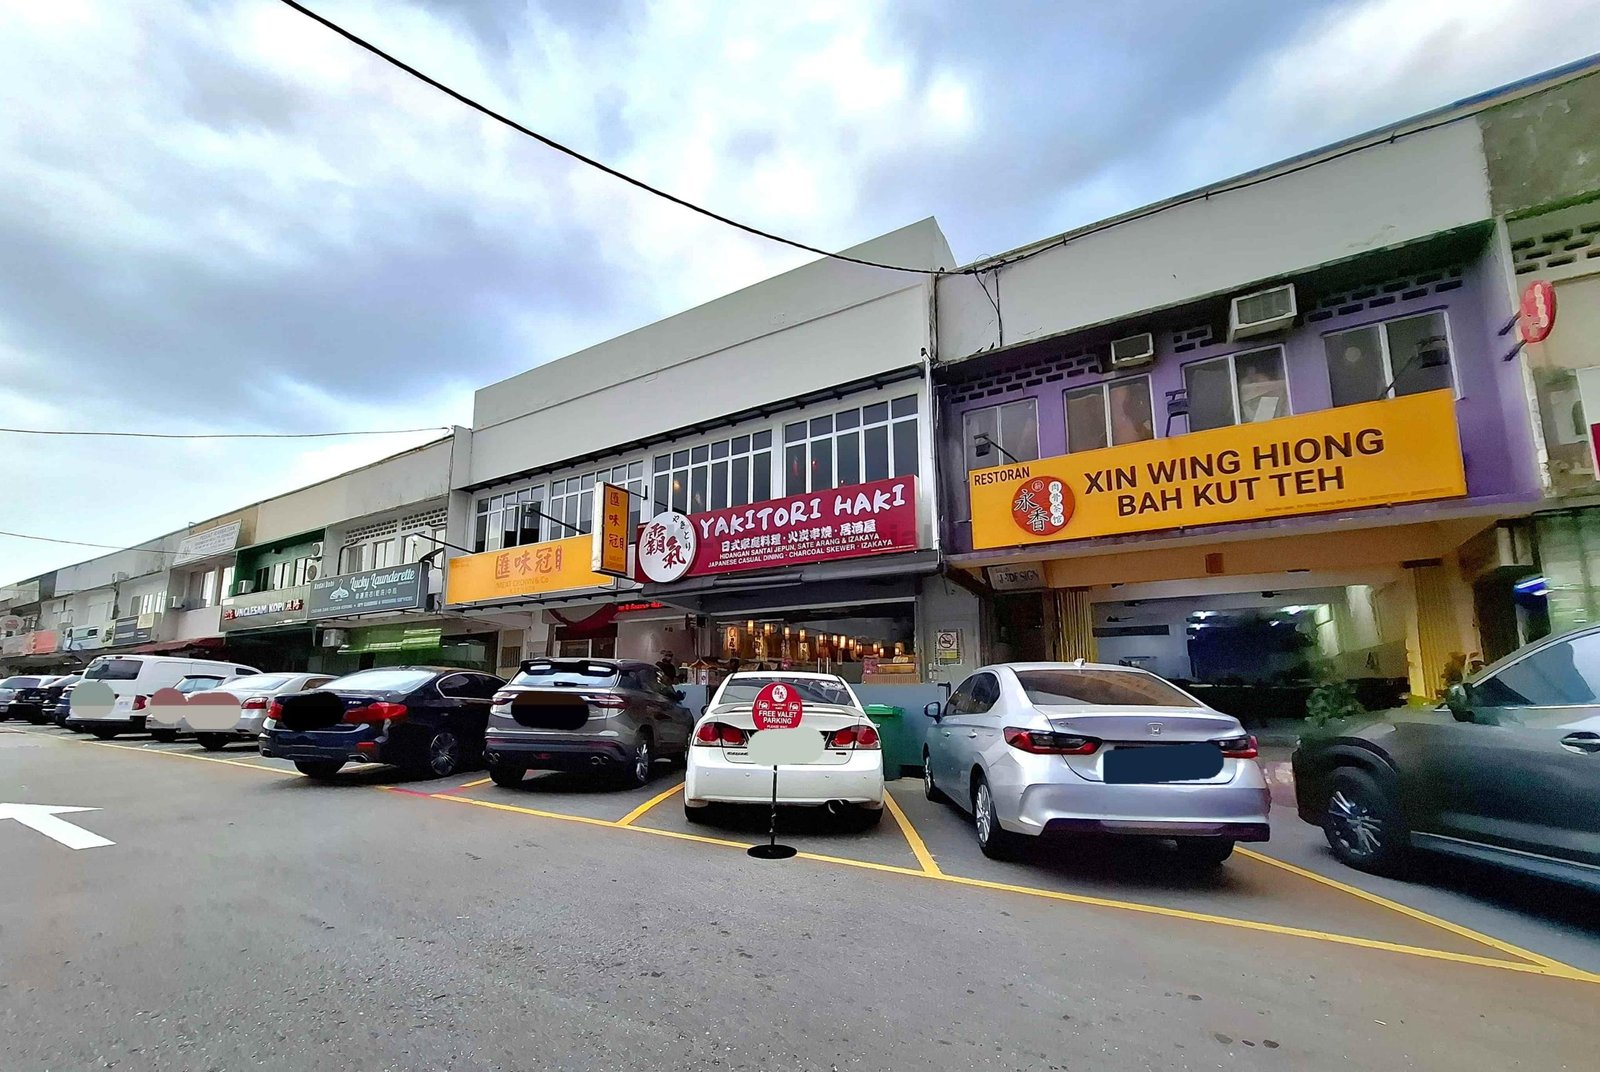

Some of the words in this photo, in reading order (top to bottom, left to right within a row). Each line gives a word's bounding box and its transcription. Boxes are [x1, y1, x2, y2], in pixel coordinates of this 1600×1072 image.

[1084, 465, 1137, 495] XIN
[1147, 450, 1240, 485] WING
[1253, 428, 1385, 470] HIONG
[974, 466, 1030, 486] RESTORAN
[1117, 487, 1182, 517] BAH
[1193, 477, 1261, 507] KUT
[1269, 466, 1345, 496] TEH
[700, 498, 821, 539] YAKITORI
[834, 483, 905, 516] HAKI
[708, 559, 737, 568] JAPANESE
[738, 556, 762, 565] CASUAL
[763, 553, 784, 562] DINING
[789, 548, 825, 558] CHARCOAL
[826, 544, 856, 553] SKEWER
[861, 539, 893, 549] IZAKAYA
[720, 551, 750, 560] HIDANGAN
[751, 547, 773, 557] SANTAI
[798, 541, 815, 550] SATE
[816, 538, 840, 547] ARANG
[848, 533, 880, 543] IZAKAYA
[350, 575, 370, 592] Lucky
[370, 567, 415, 590] Launderette
[269, 602, 285, 612] KOPI
